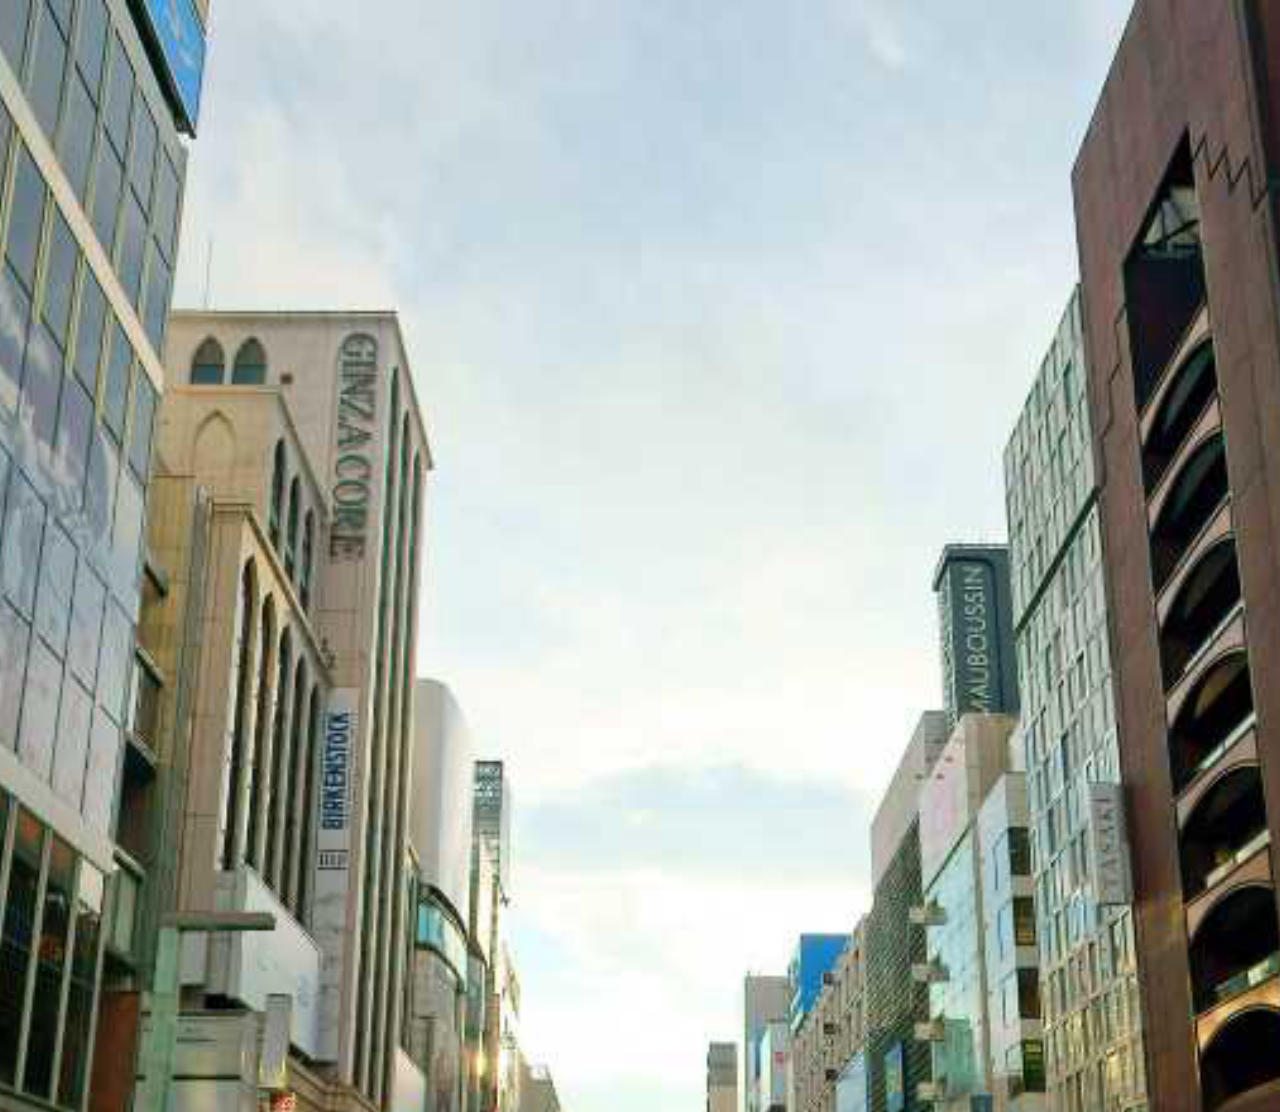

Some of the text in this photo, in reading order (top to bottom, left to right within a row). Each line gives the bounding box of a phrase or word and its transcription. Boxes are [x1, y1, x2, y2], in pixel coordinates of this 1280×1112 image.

[328, 331, 380, 563] GINZA CORE
[321, 711, 352, 830] BIRKENSTOCK
